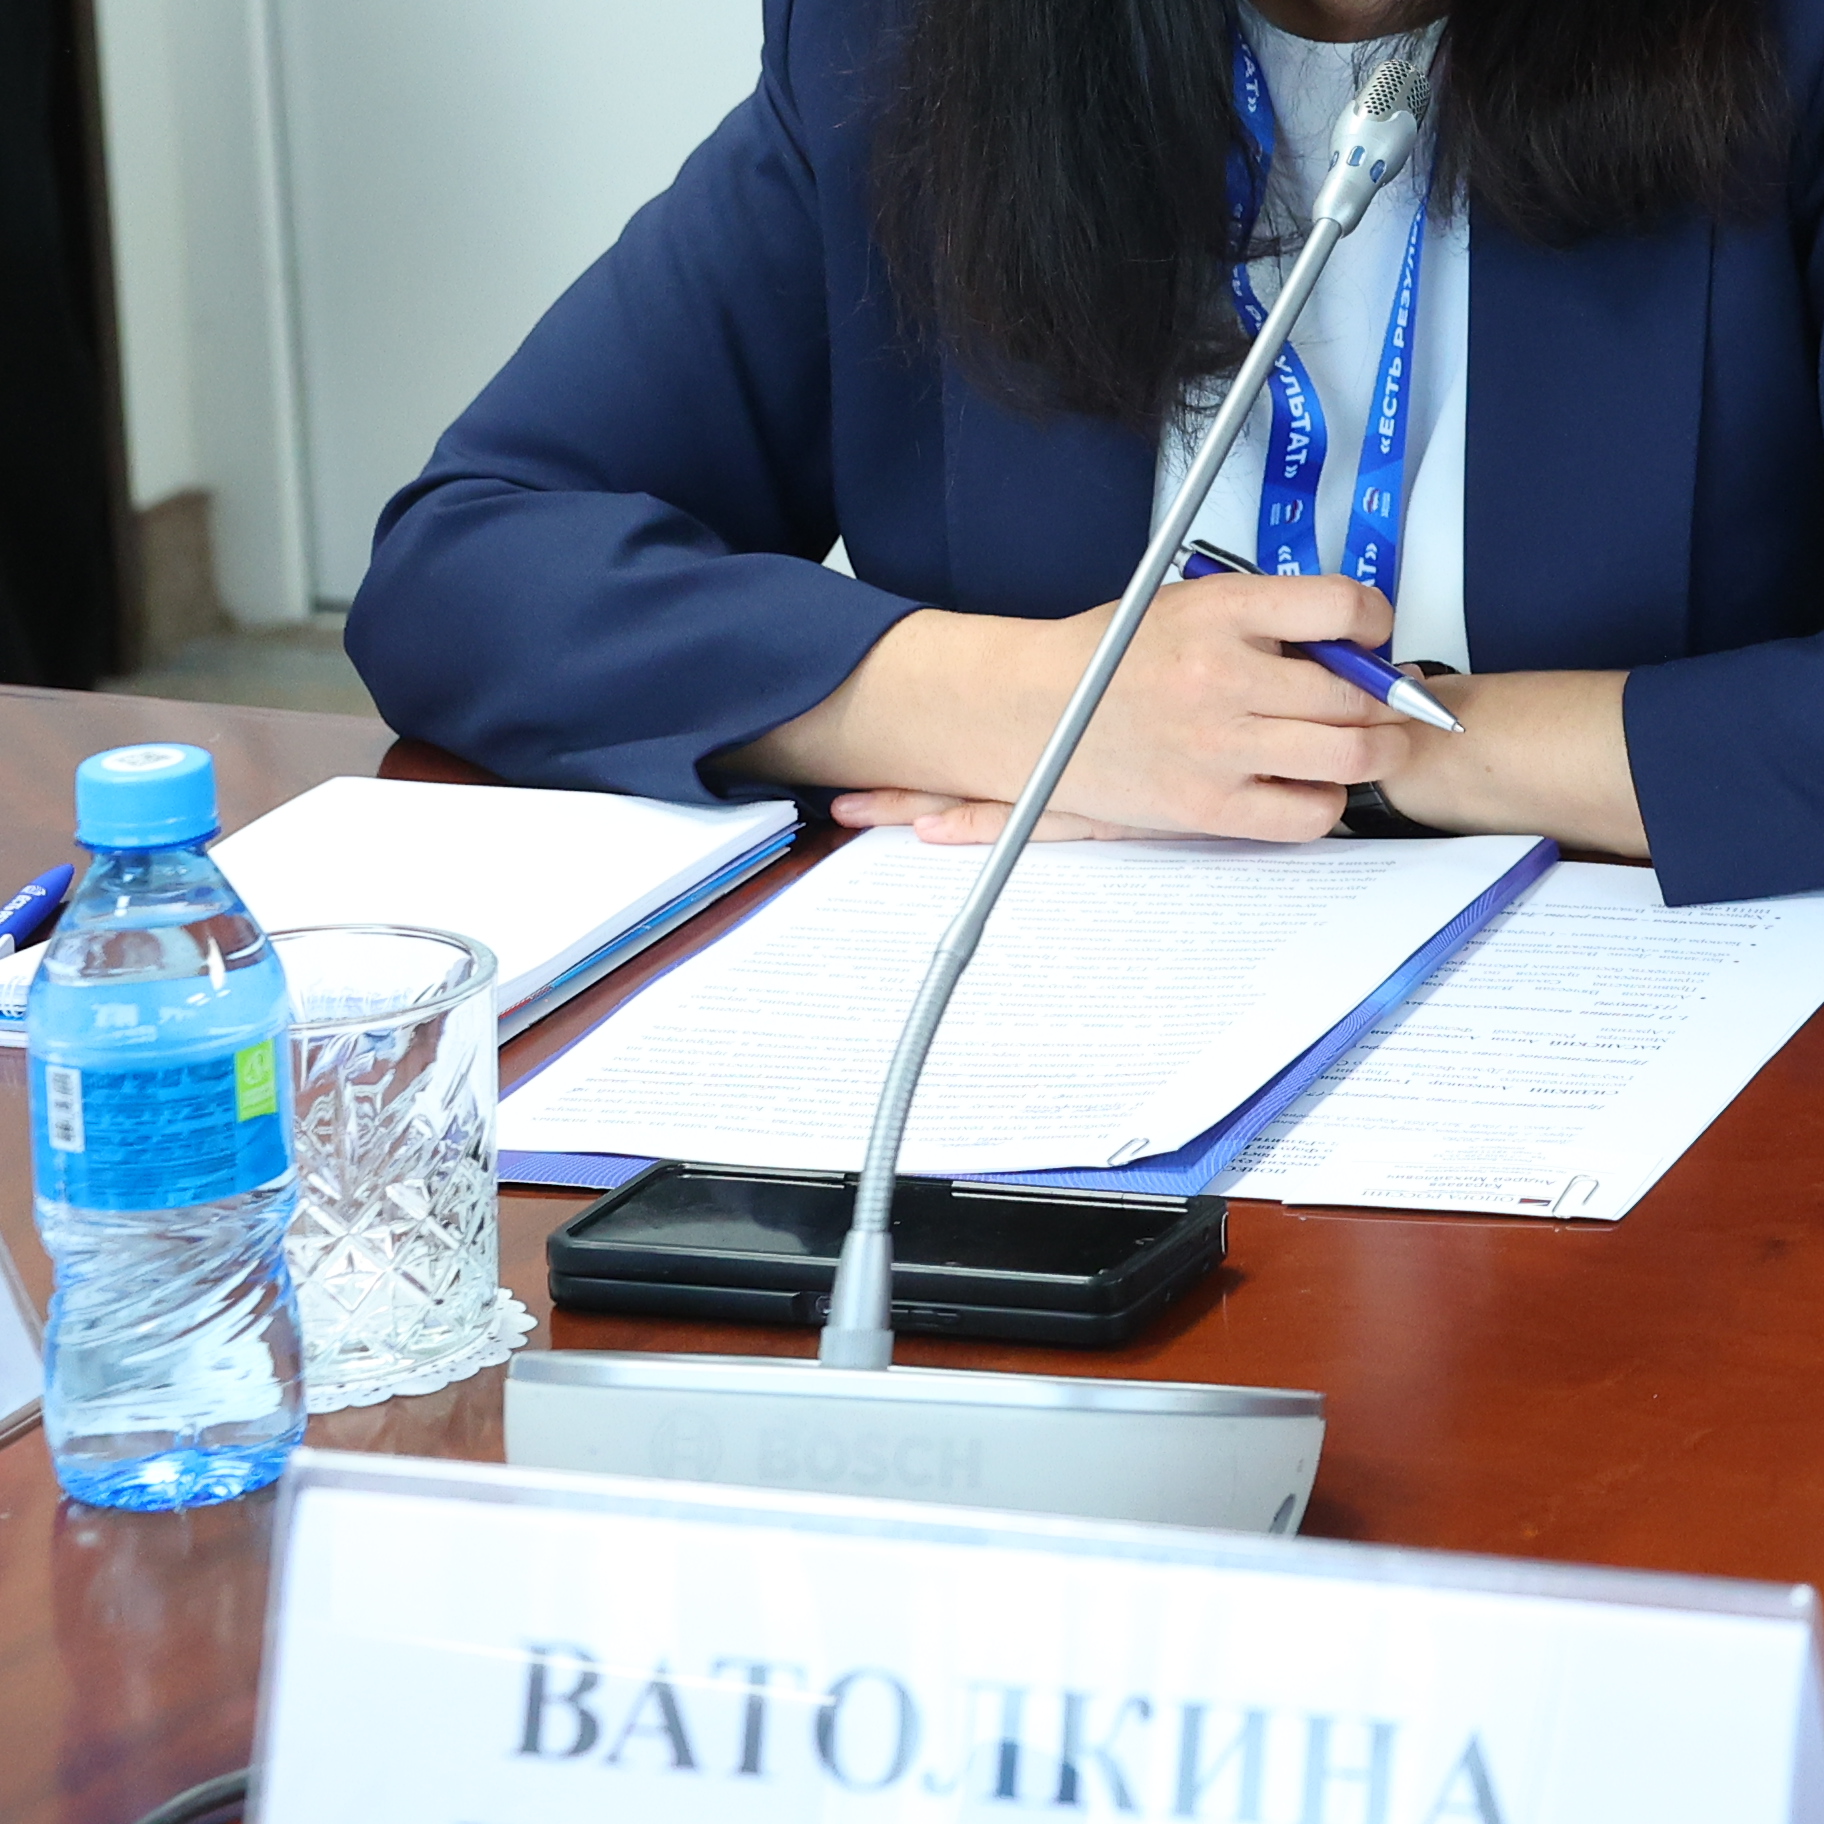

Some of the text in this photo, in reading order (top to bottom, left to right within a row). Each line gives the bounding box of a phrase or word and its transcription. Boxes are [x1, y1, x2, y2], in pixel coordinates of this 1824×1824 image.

[1379, 356, 1403, 454] «ЕСТЬ
[1359, 1189, 1515, 1202] ОПОРА РОССИИ
[1383, 1171, 1558, 1186] Андрей Михайлович
[1426, 1179, 1504, 1190] Караваев
[755, 1426, 983, 1490] BOSCH
[502, 1636, 1510, 1824] ВАТОЛКИНА
